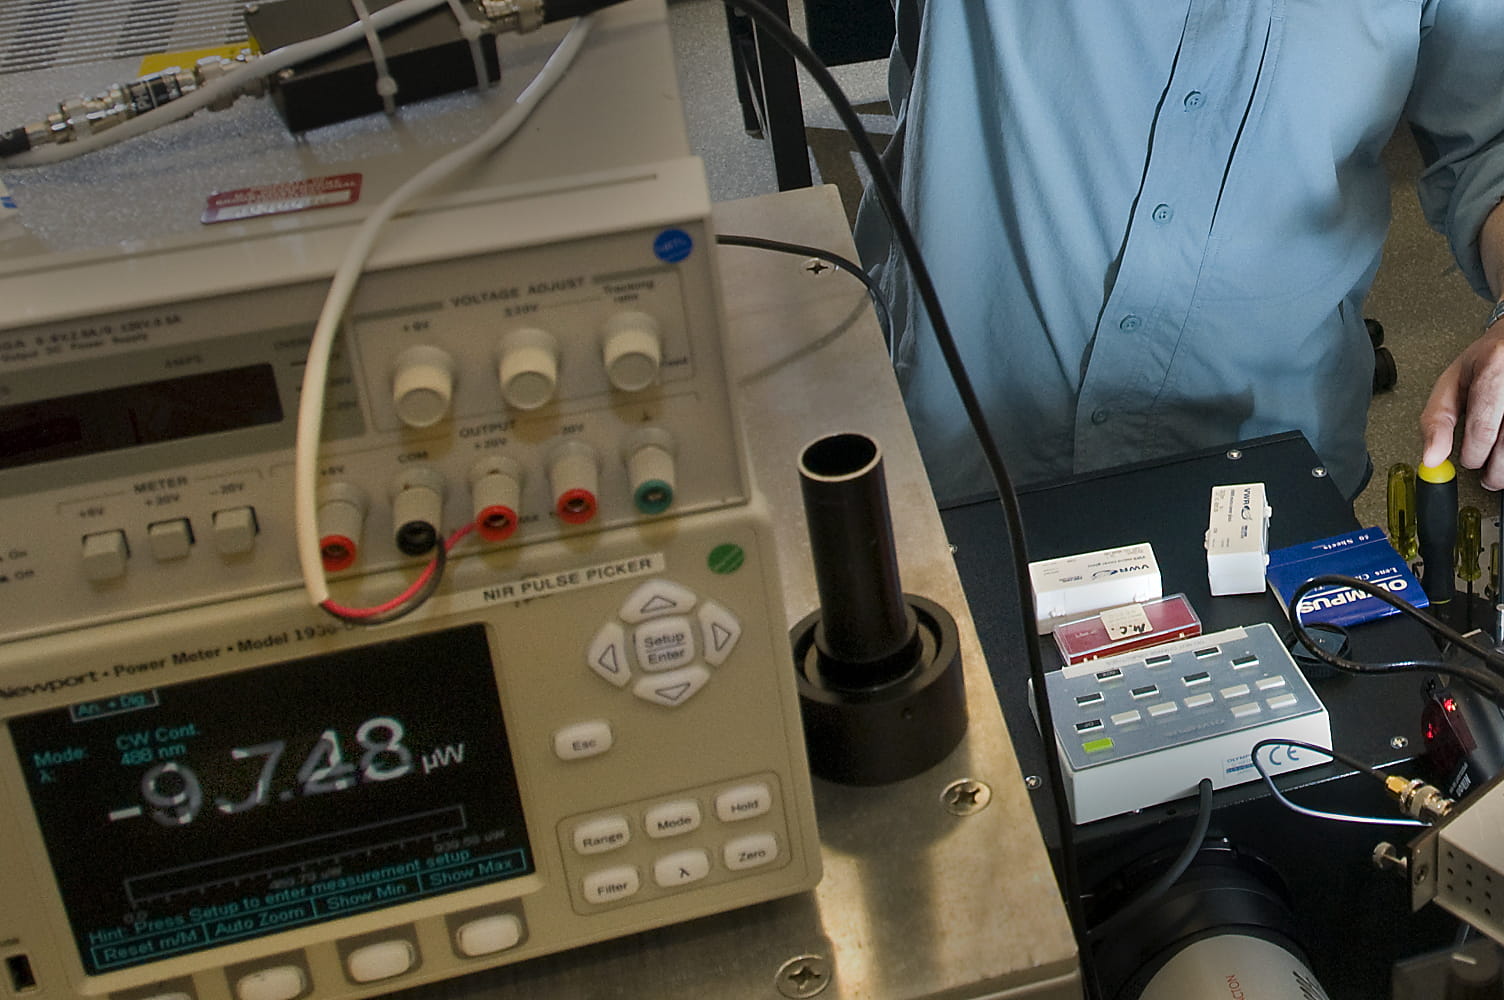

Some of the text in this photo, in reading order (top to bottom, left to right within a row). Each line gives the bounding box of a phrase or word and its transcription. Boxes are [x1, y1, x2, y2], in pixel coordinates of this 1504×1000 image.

[451, 276, 585, 308] VOLTAGE ADJUST
[458, 418, 516, 439] OUTPUT
[134, 476, 188, 495] METER
[1242, 487, 1252, 510] VWR
[1117, 563, 1150, 574] VWR
[1373, 566, 1399, 577] Lens
[482, 557, 654, 604] NIR PULSE PICKER
[1299, 579, 1409, 615] OLMPUS
[643, 630, 685, 650] Setup
[113, 659, 166, 678] Power
[171, 646, 221, 667] Meter
[237, 631, 288, 653] Model
[647, 647, 686, 666] Enter
[116, 731, 149, 751] CW
[572, 738, 597, 752] Esc
[121, 749, 153, 767] 488
[157, 742, 187, 759] nm
[730, 799, 759, 815] Hold
[657, 814, 693, 832] Mode
[582, 831, 624, 850] Range
[738, 846, 767, 863] Zero
[429, 858, 514, 887] Show Max
[134, 912, 185, 934] Press
[188, 901, 239, 921] Setup
[243, 896, 261, 910] to
[265, 885, 307, 904] enter
[311, 858, 422, 893] measurement
[425, 849, 471, 869] setup
[326, 883, 407, 912] Show Min
[597, 879, 628, 897] Filter
[214, 906, 306, 937] Auto Zoom
[103, 930, 200, 963] Reset m/M
